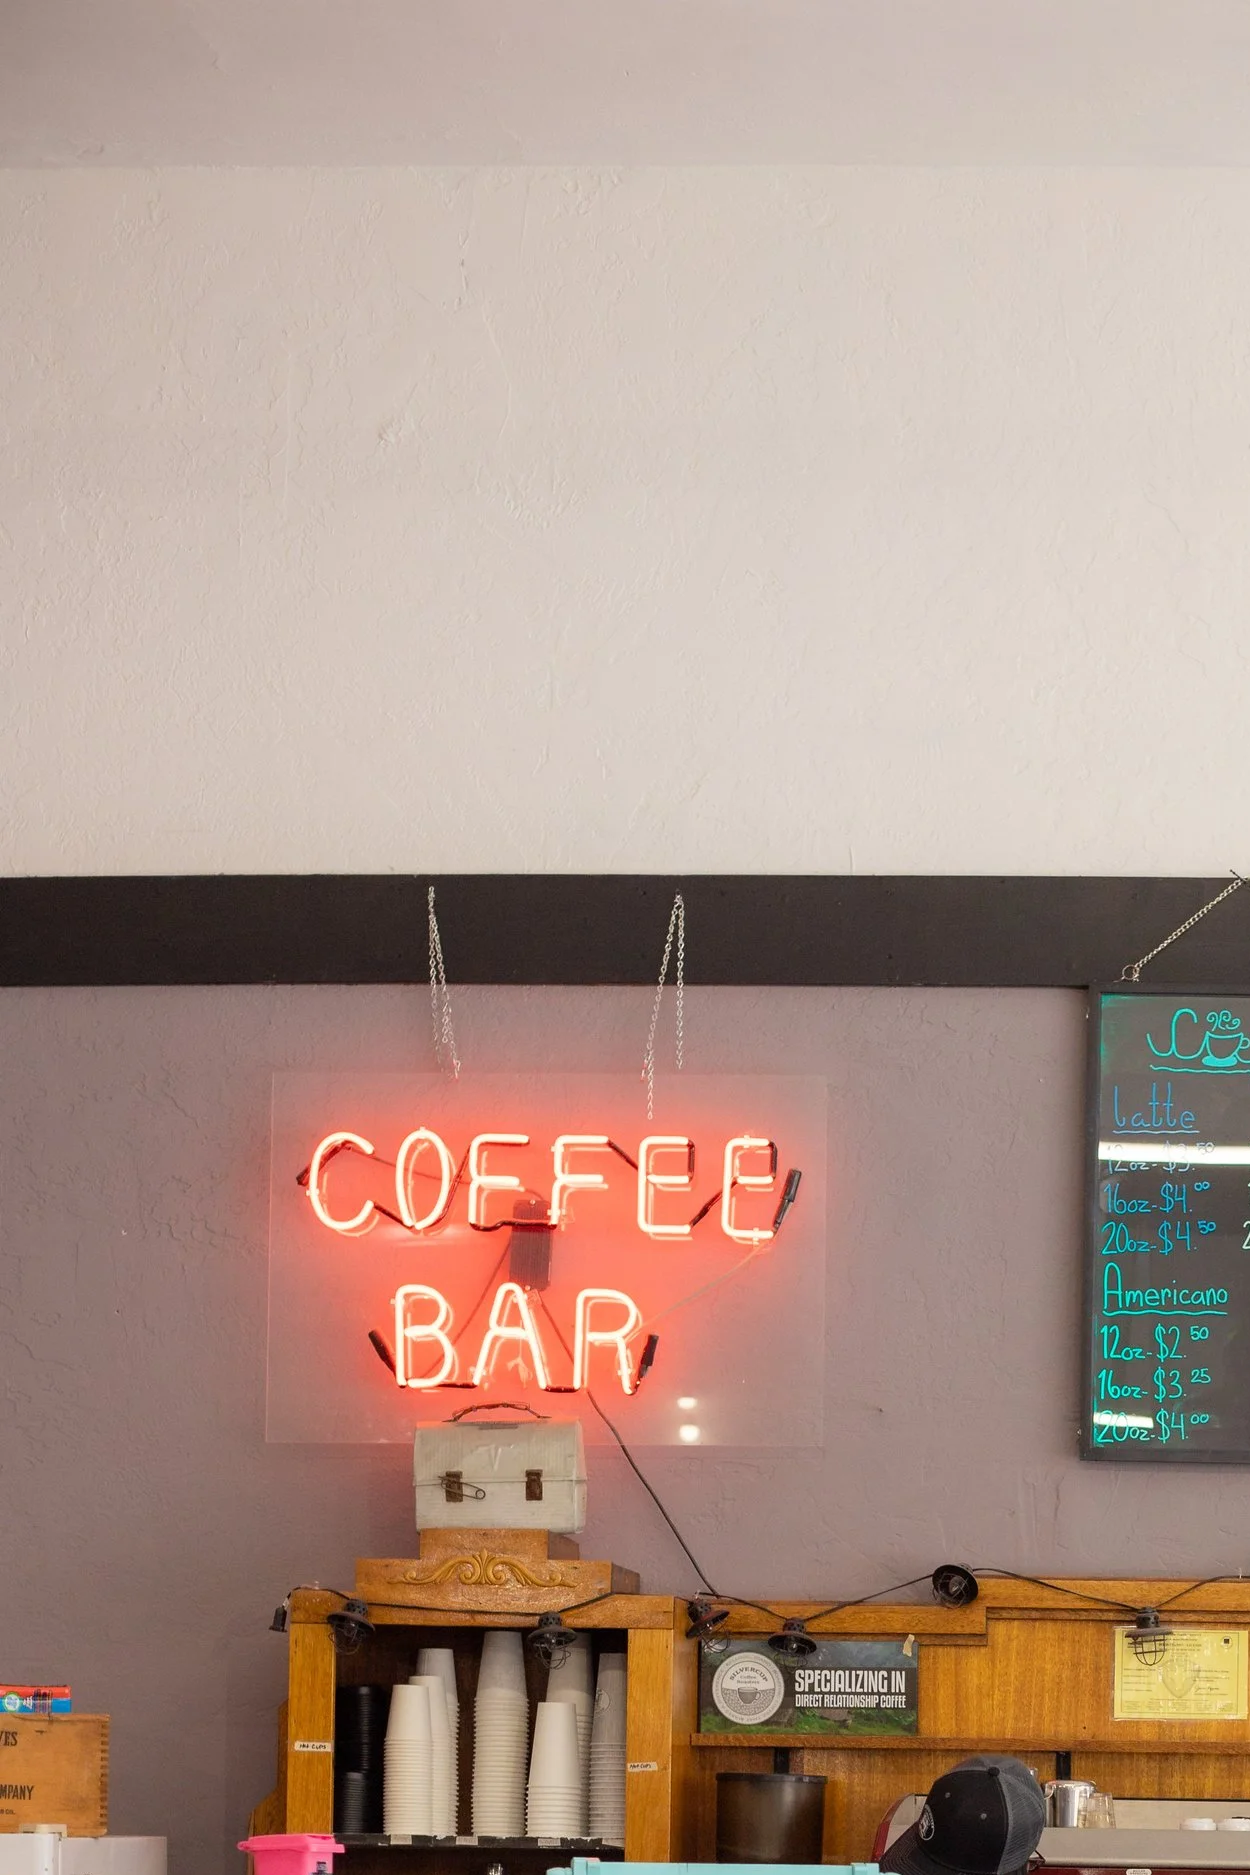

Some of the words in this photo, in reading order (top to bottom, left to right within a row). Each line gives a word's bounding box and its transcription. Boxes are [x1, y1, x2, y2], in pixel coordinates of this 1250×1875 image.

[308, 1127, 776, 1239] COFFEE
[1103, 1262, 1228, 1310] Americano
[395, 1282, 637, 1395] BAR
[729, 1666, 768, 1682] SILVERCUP
[794, 1669, 888, 1692] SPECIALIZING
[890, 1670, 906, 1693] IN
[795, 1694, 823, 1708] DIRECT
[823, 1694, 880, 1708] RELATIONSHIP
[880, 1695, 907, 1709] COFFEE
